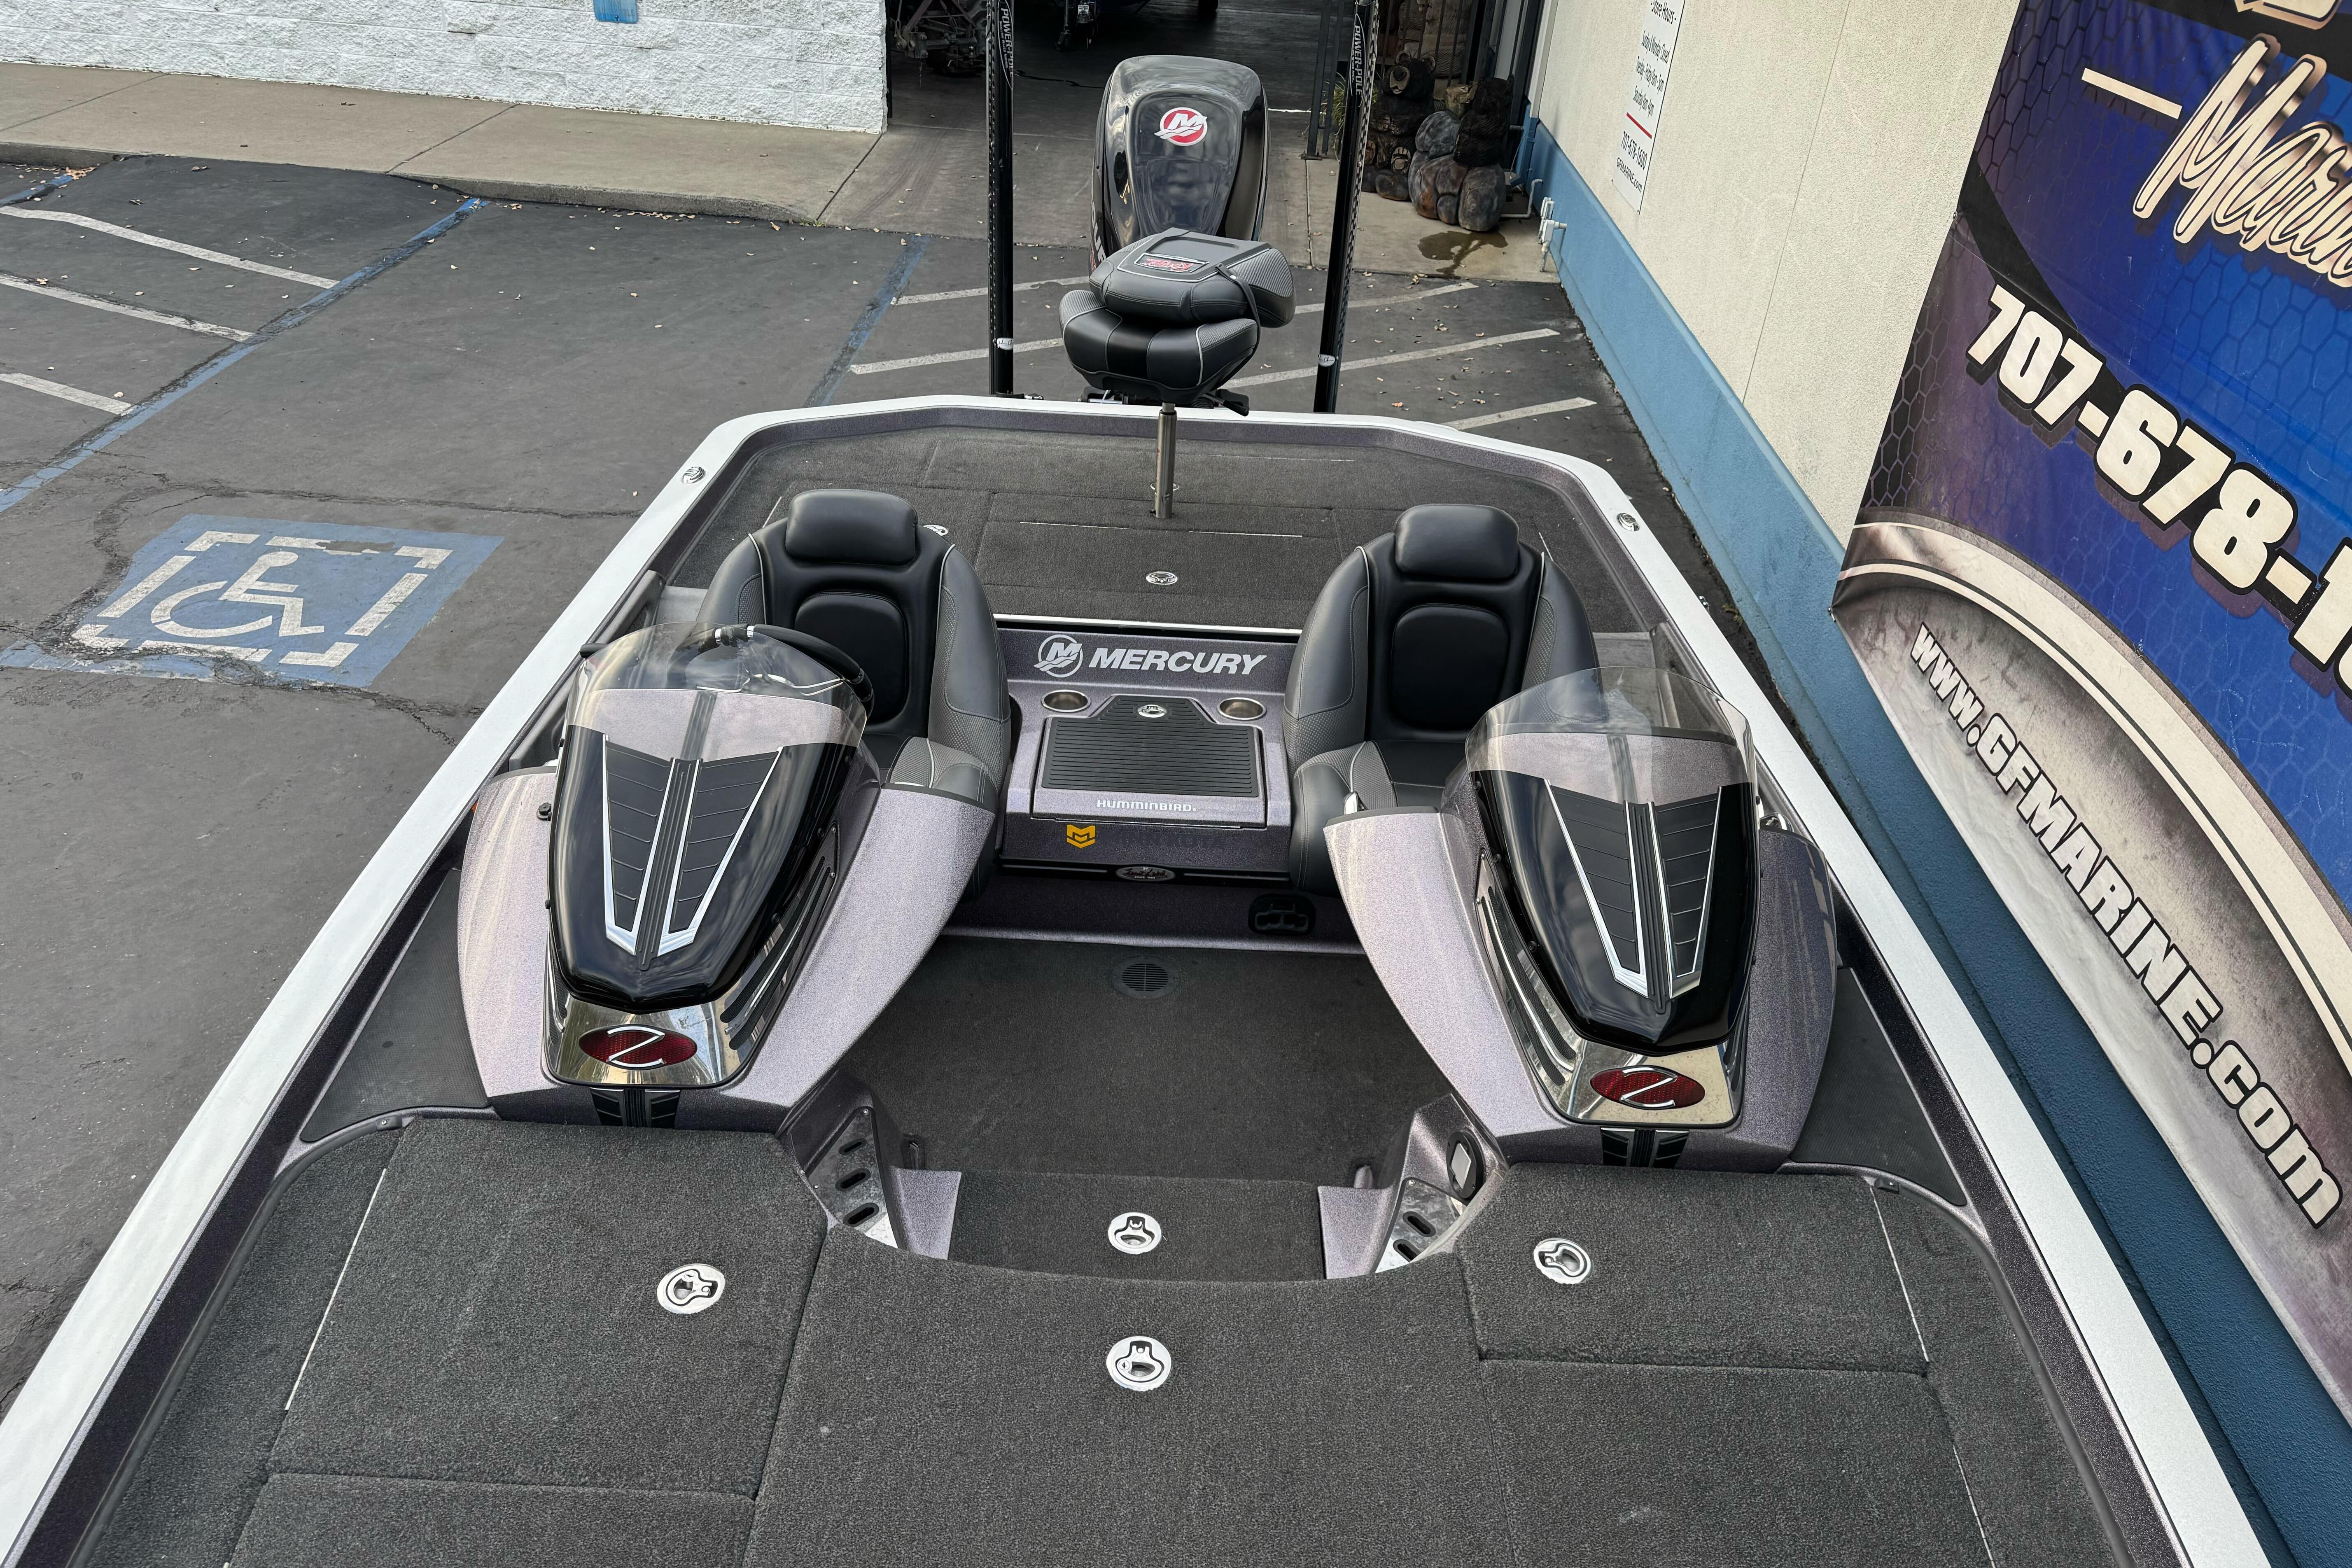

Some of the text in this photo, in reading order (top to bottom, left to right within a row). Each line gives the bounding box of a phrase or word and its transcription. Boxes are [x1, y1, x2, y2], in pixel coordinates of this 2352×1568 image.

[1652, 0, 1662, 17] Store
[1661, 1, 1675, 25] Hours
[1354, 26, 1363, 96] POWER-POLE
[1621, 131, 1647, 170] 707-678-1600
[1617, 157, 1643, 193] GFMARINE.com
[1088, 647, 1267, 675] MERCURY
